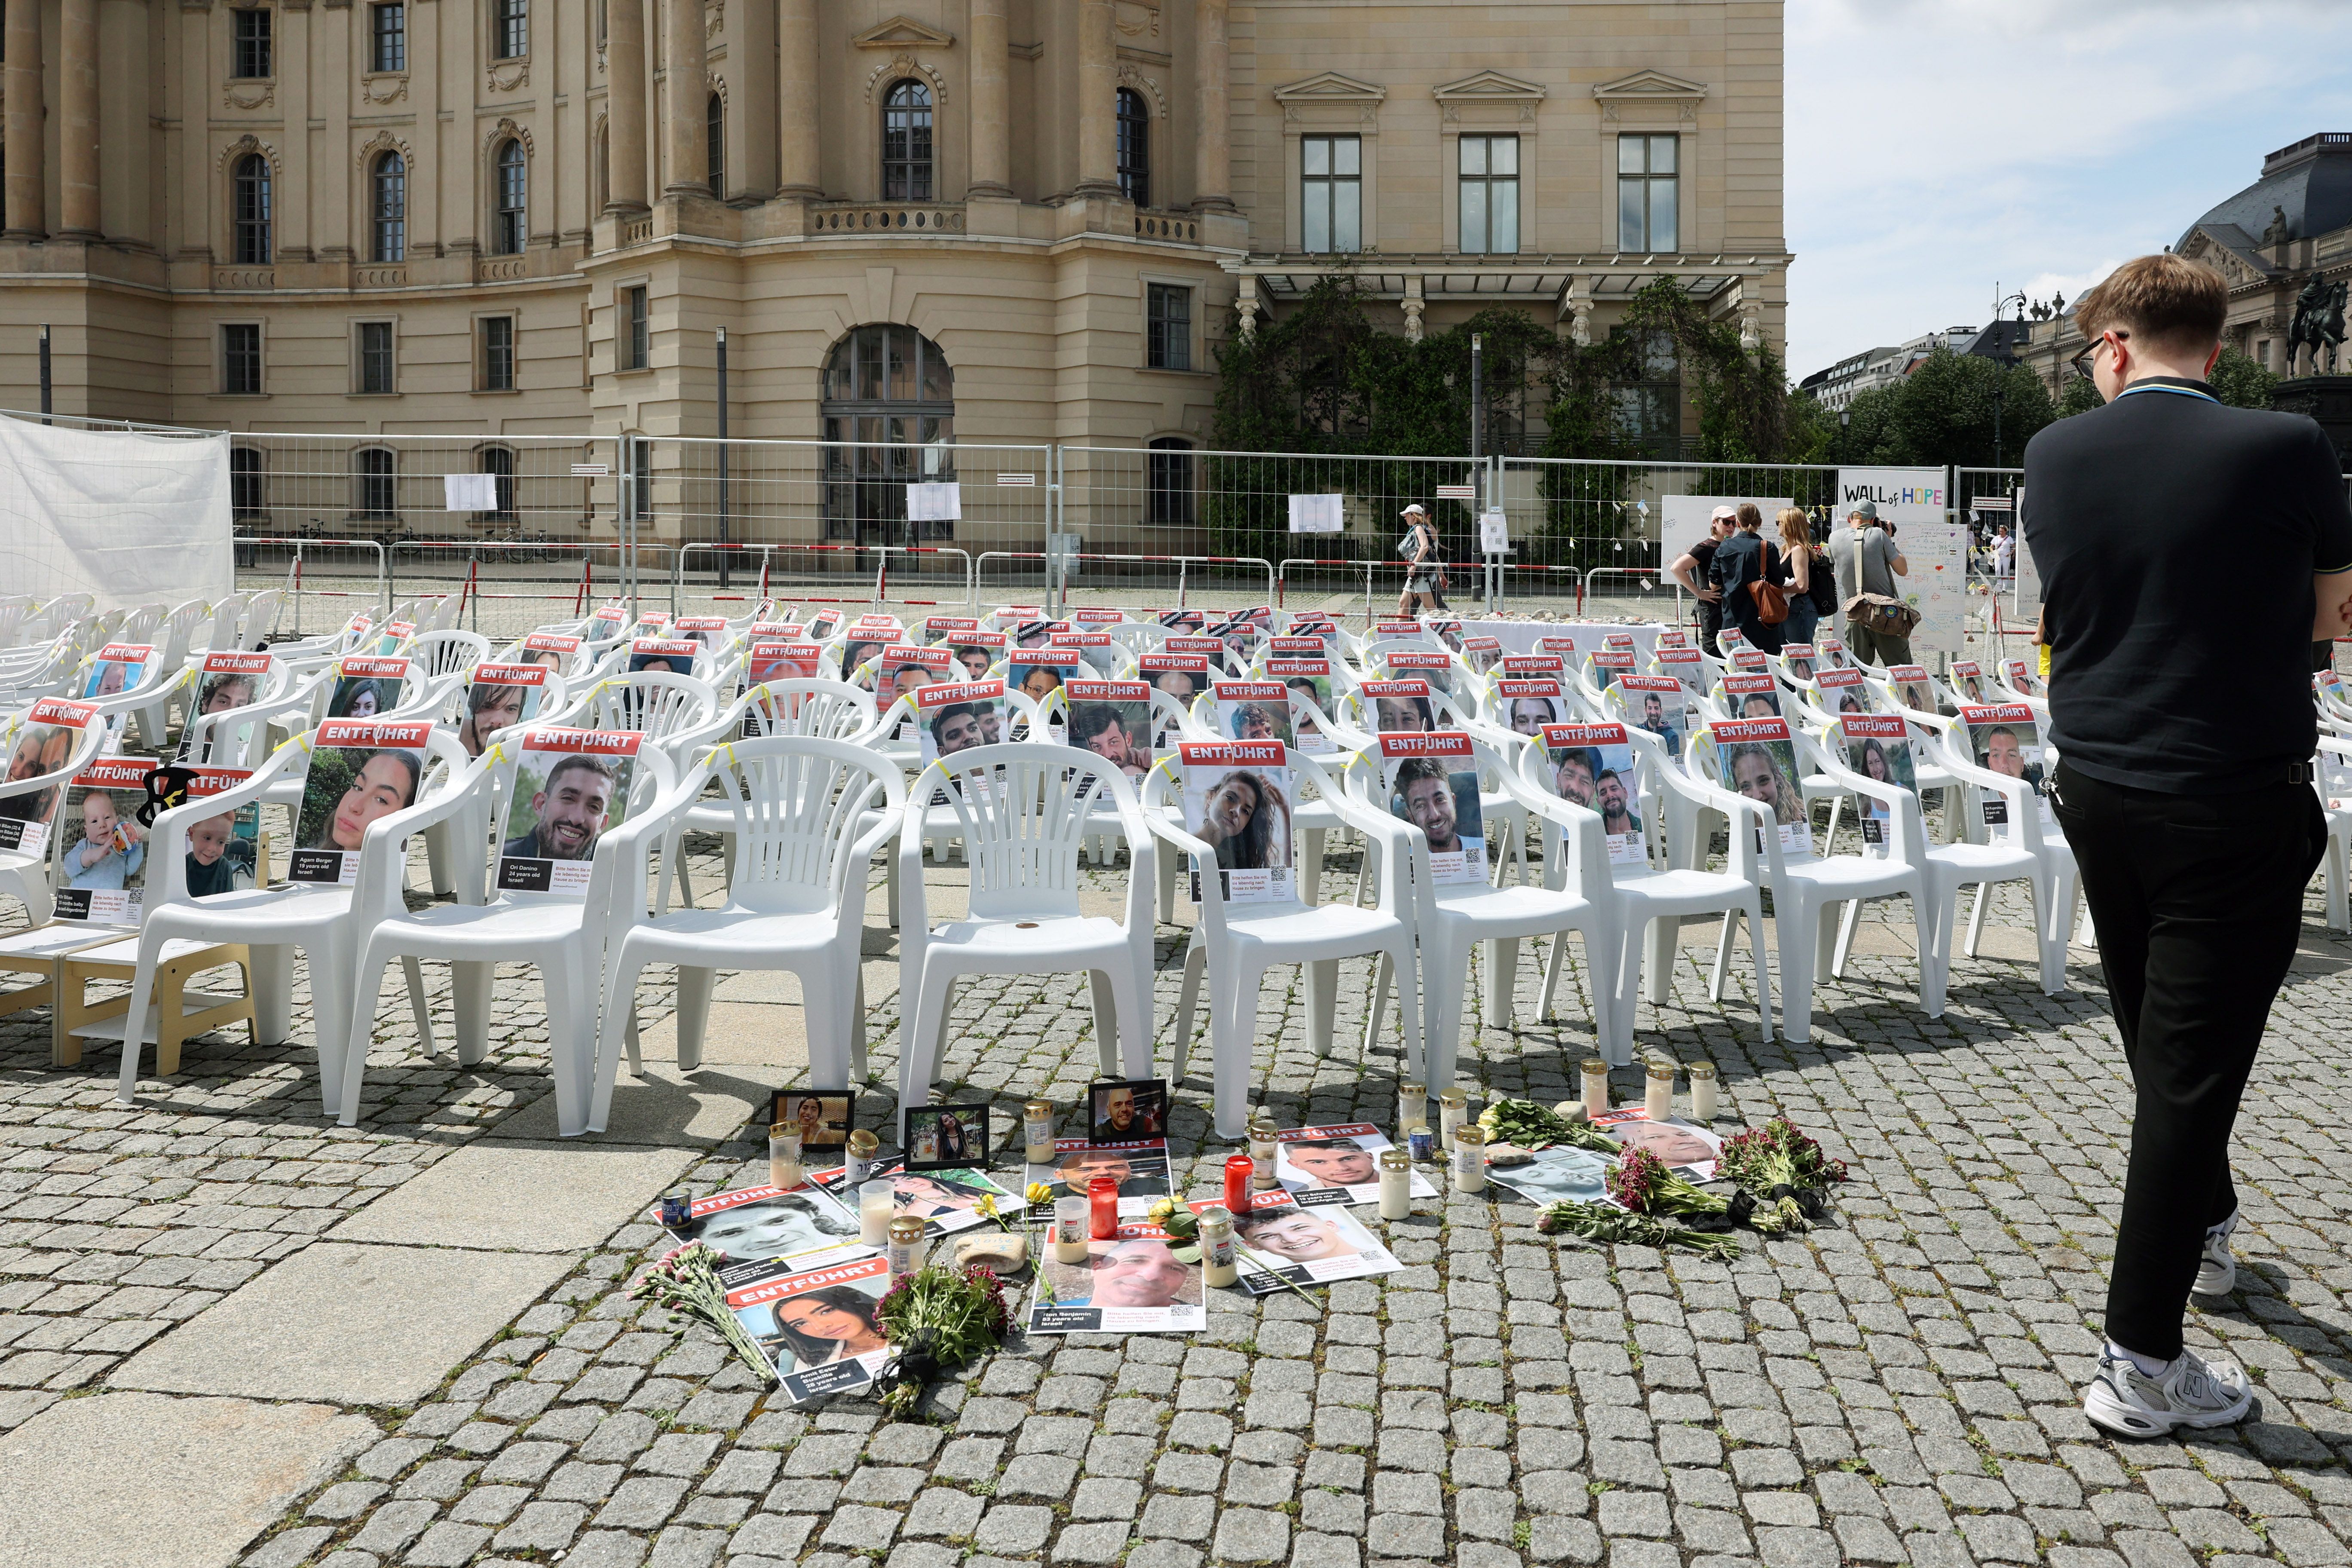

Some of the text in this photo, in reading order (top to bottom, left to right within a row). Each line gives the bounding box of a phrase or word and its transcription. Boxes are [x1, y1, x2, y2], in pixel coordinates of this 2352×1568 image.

[1844, 485, 1942, 507] WALL of HOPE
[755, 625, 799, 634] ENTFÜHRT
[852, 630, 898, 638] ENTFÜHRT
[530, 638, 575, 649] ENTFÜHRT
[952, 634, 1001, 643] ENTFÜHRT
[638, 642, 692, 651] ENTFÜHRT
[759, 647, 815, 656] ENTFÜHRT
[104, 647, 146, 658] ENTFÜHRT
[889, 649, 946, 661] ENTFÜHRT
[1016, 652, 1073, 661] ENTFÜHRT
[1661, 651, 1697, 660] ENTFÜHRT
[211, 658, 266, 668] ENTFÜHRT
[1145, 658, 1202, 667] ENTFÜHRT
[1393, 656, 1445, 665] ENTFÜHRT
[1508, 659, 1557, 668] ENTFÜHRT
[1596, 654, 1630, 663] ENTFÜHRT
[346, 662, 403, 672] ENTFÜHRT
[1272, 663, 1324, 672] ENTFÜHRT
[481, 668, 541, 680] ENTFÜHRT
[1820, 673, 1857, 684] ENTFÜHRT
[1894, 670, 1923, 678] ENTFÜHRT
[1367, 682, 1422, 692] ENTFÜHRT
[1504, 682, 1554, 693] ENTFÜHRT
[1625, 677, 1675, 688] ENTFÜHRT
[1727, 678, 1770, 689] ENTFÜHRT
[925, 684, 997, 701] ENTFÜHRT
[1074, 682, 1143, 695] ENTFÜHRT
[1222, 684, 1280, 695] ENTFÜHRT
[36, 704, 90, 721] ENTFÜHRT
[1967, 707, 2026, 718] ENTFÜHRT
[1718, 723, 1781, 737] ENTFÜHRT
[1847, 719, 1899, 732] ENTFÜHRT
[326, 724, 422, 741] ENTFÜHRT
[1550, 727, 1618, 741] ENTFÜHRT
[534, 731, 632, 747] ENTFÜHRT
[1388, 735, 1464, 750] ENTFÜHRT
[1189, 744, 1276, 759] ENTFÜHRT
[80, 765, 150, 781] ENTFÜHRT
[1279, 1126, 1364, 1139] NTFÜHRT
[722, 1267, 755, 1279] Hernandez
[726, 1268, 775, 1285] Mexican-French
[734, 1273, 750, 1281] years
[740, 1262, 877, 1303] ENTFÜHRT
[802, 1372, 833, 1384] Buskilla
[816, 1377, 838, 1387] years
[808, 1384, 832, 1394] Israeli
[2184, 1373, 2202, 1398] N
